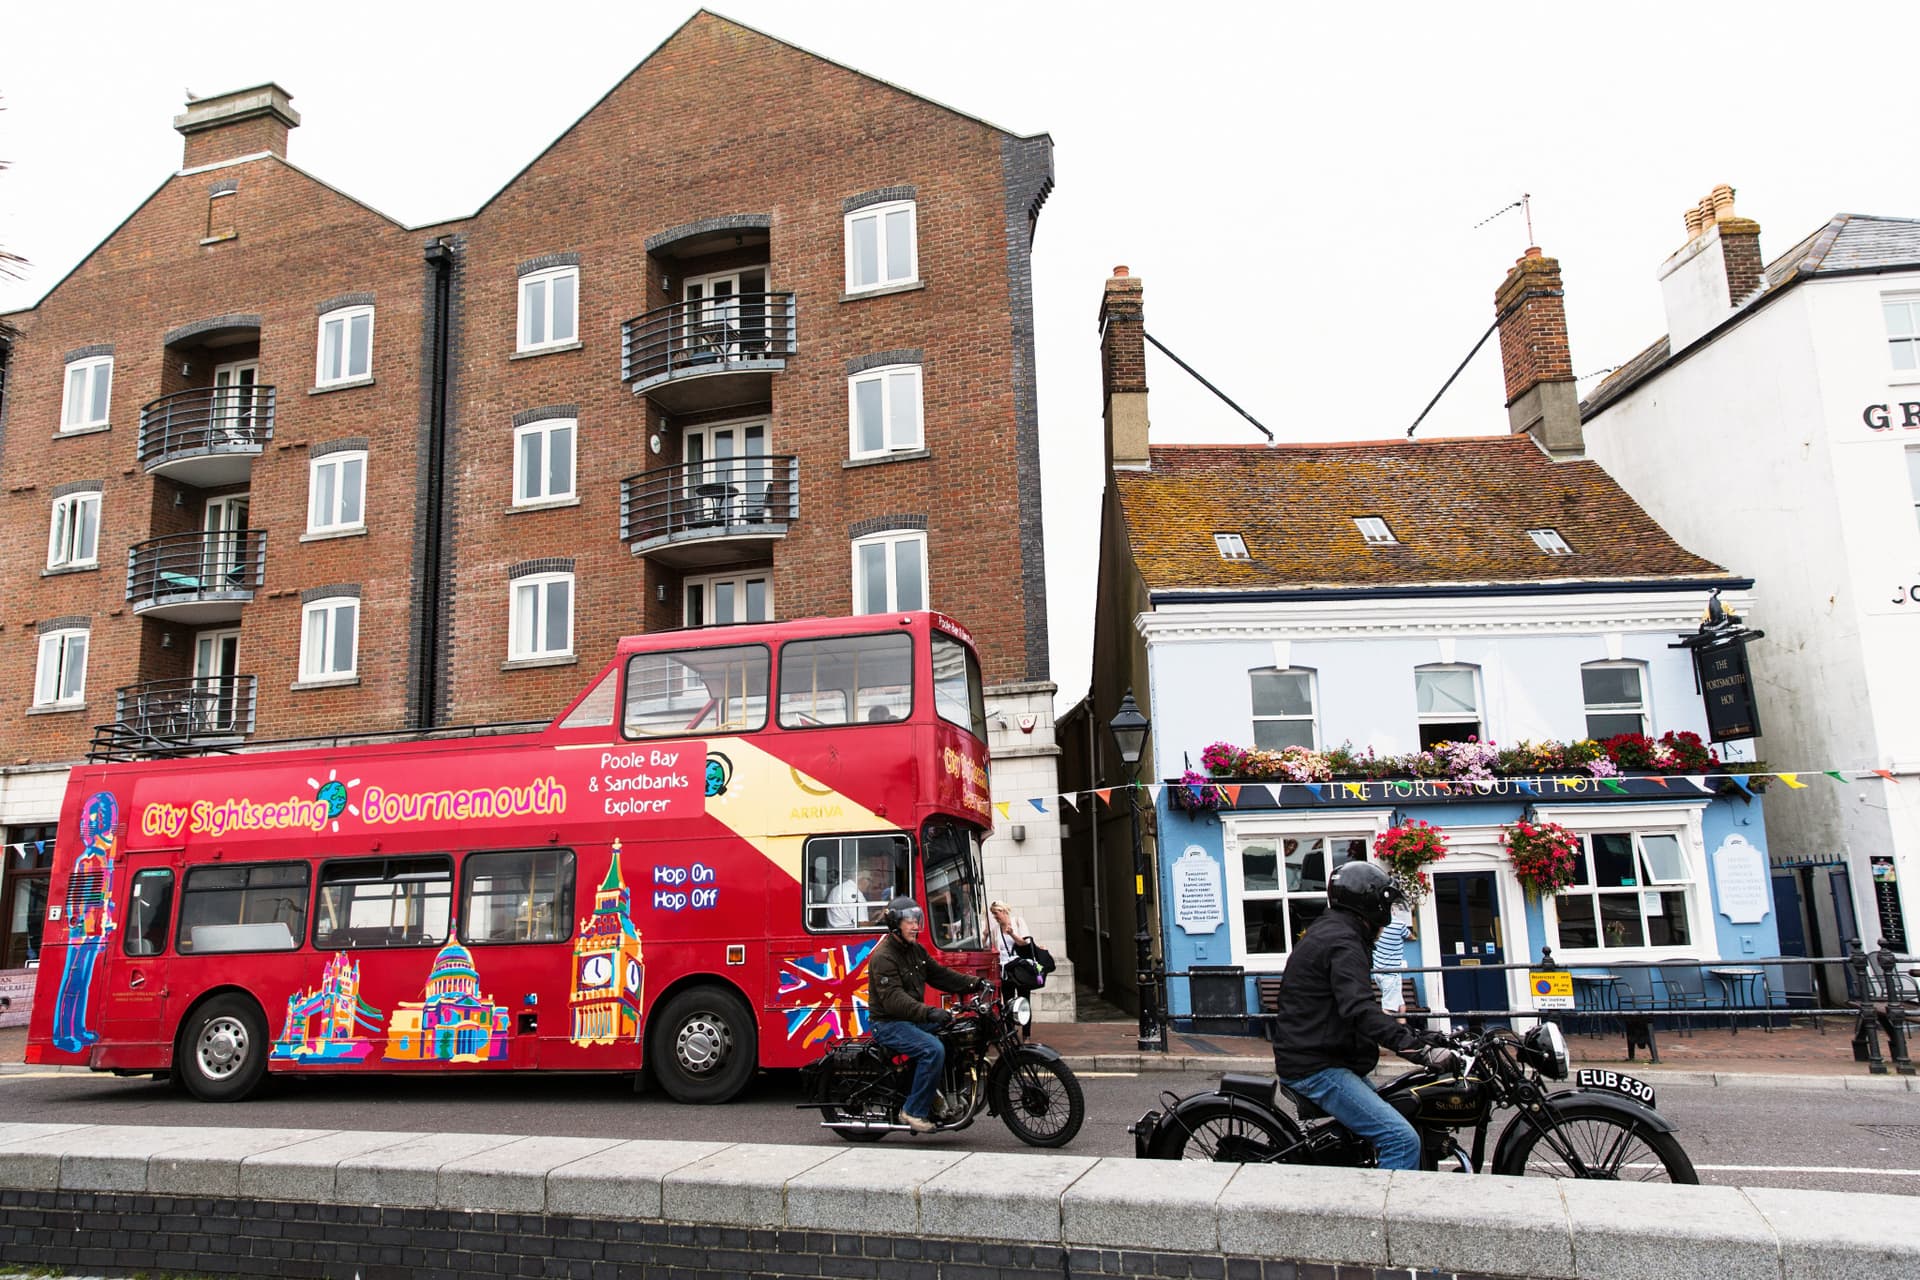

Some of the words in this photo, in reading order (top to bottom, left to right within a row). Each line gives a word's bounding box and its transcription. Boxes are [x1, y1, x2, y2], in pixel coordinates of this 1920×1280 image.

[1715, 659, 1728, 670] THE
[1706, 674, 1746, 690] PORTSMOUTH
[1720, 694, 1735, 705] HOY
[600, 751, 645, 769] Poole
[649, 750, 679, 768] Bay
[588, 776, 599, 792] &
[604, 772, 689, 792] Sandbanks
[1552, 775, 1600, 793] HOY
[142, 803, 187, 837] City
[191, 796, 329, 837] Sightseeing
[363, 776, 566, 824] Bournemouth
[604, 797, 671, 817] Explorer
[789, 805, 844, 819] ARRIVA
[653, 866, 687, 885] Hop
[690, 863, 715, 882] On
[653, 890, 687, 911] Hop
[690, 888, 719, 908] Off
[1580, 1070, 1618, 1088] EUB
[1619, 1076, 1654, 1102] 530
